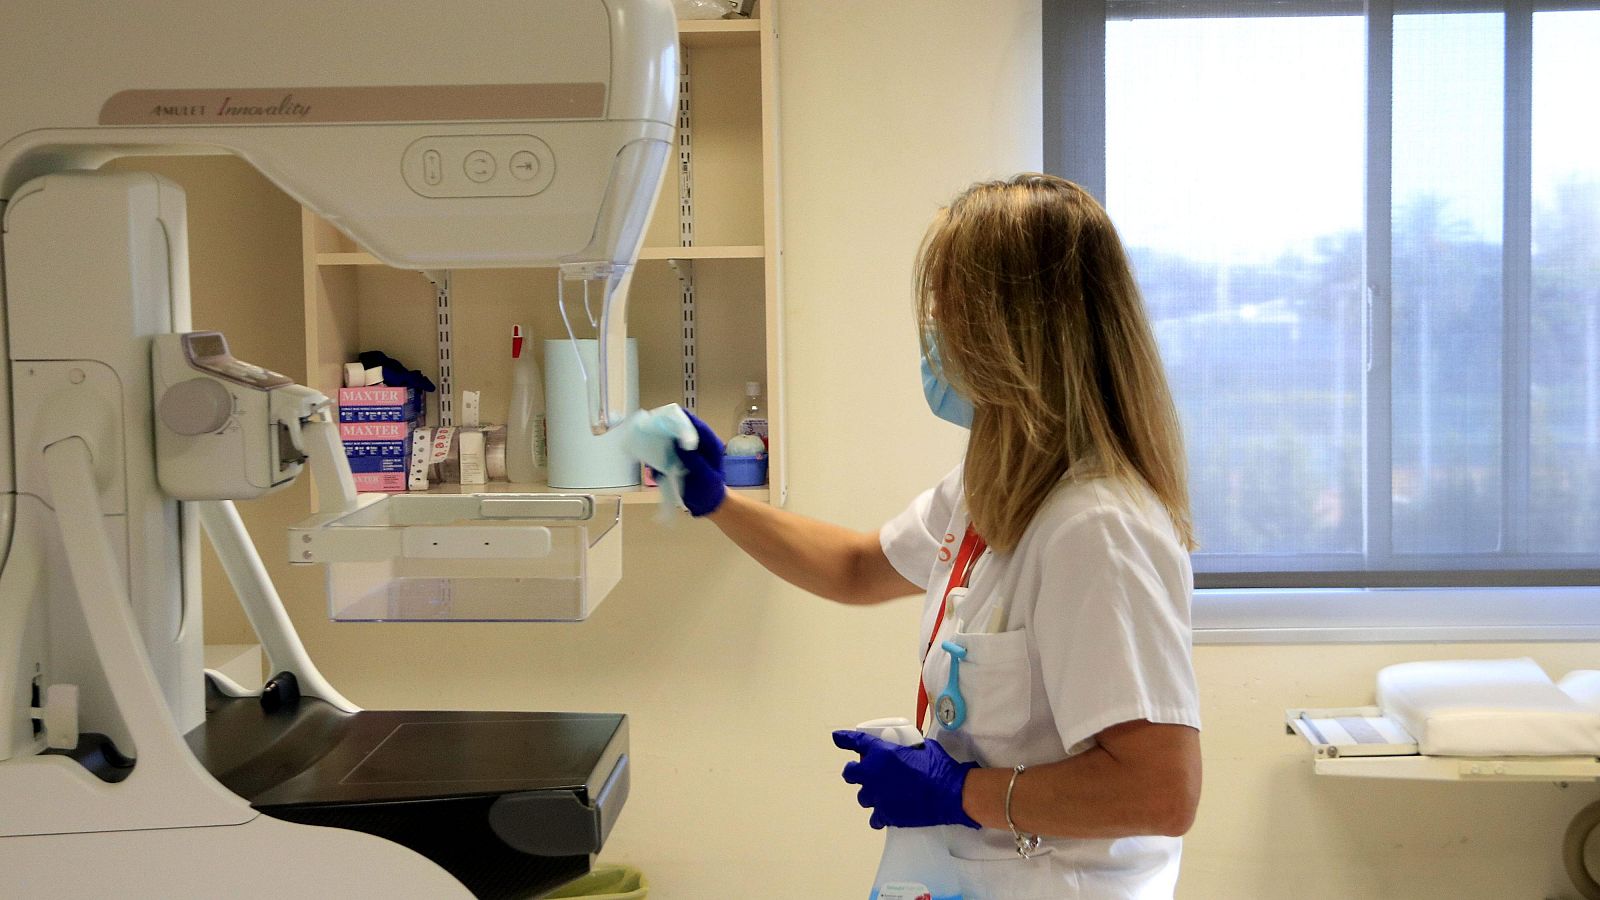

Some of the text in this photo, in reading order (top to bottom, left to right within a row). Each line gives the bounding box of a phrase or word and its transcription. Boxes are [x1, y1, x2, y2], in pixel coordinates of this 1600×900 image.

[152, 94, 312, 117] AMULET Innovality
[342, 391, 399, 401] MAXTER
[343, 425, 400, 435] MAXTER
